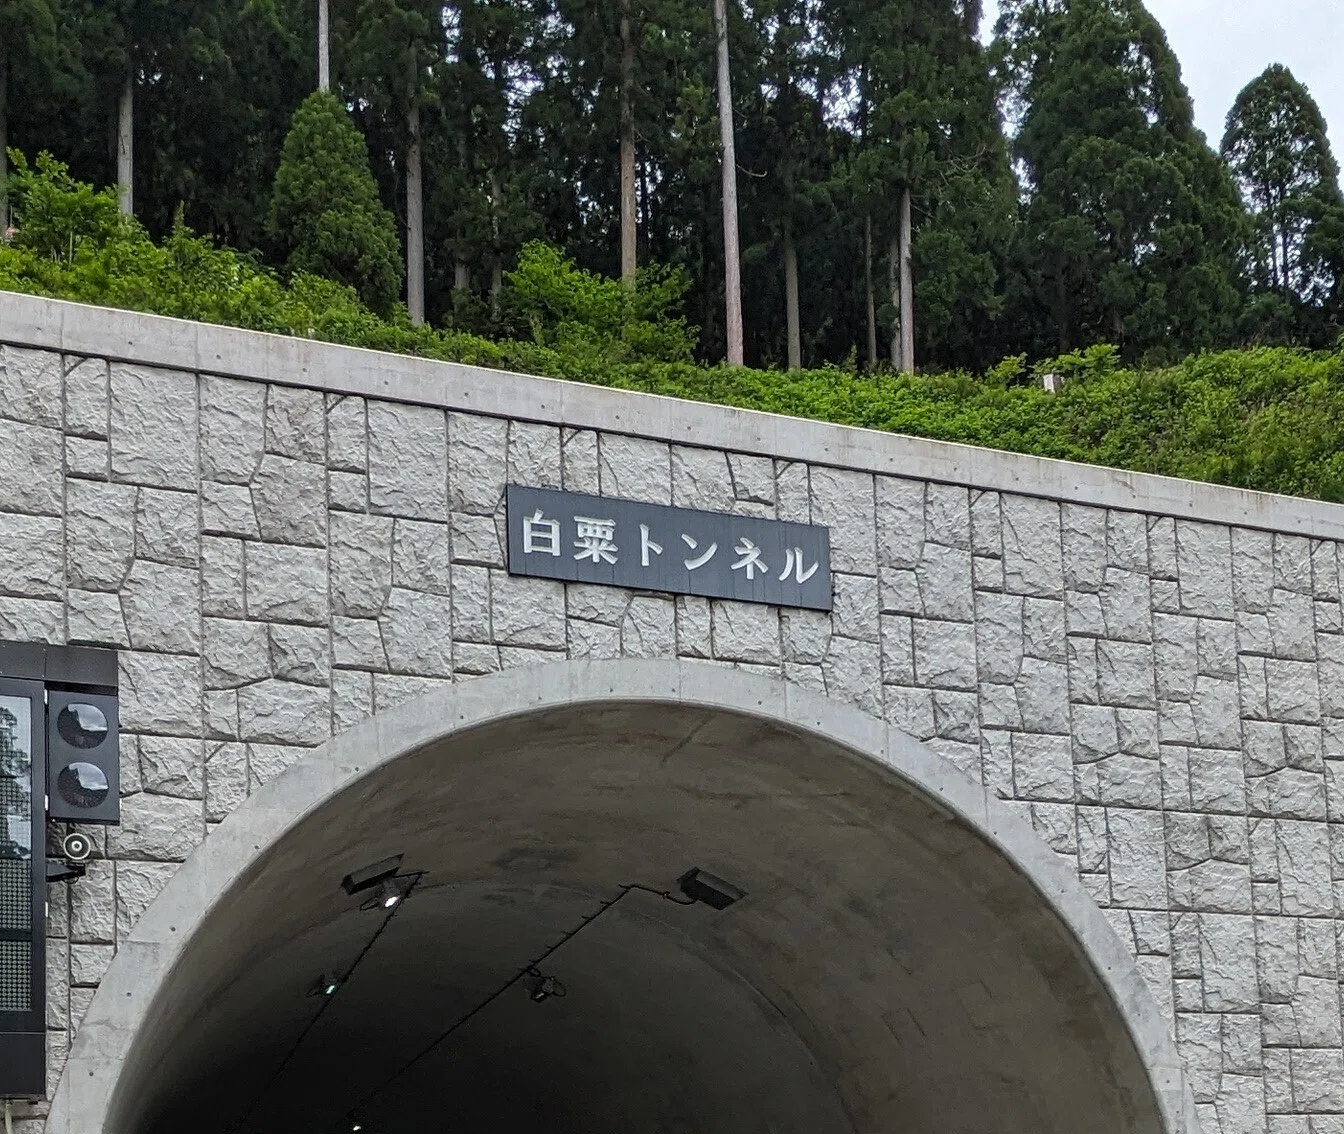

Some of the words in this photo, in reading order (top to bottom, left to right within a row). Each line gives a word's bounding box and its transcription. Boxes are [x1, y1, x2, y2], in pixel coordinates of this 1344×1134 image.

[522, 509, 819, 584] 白粟トンネル
